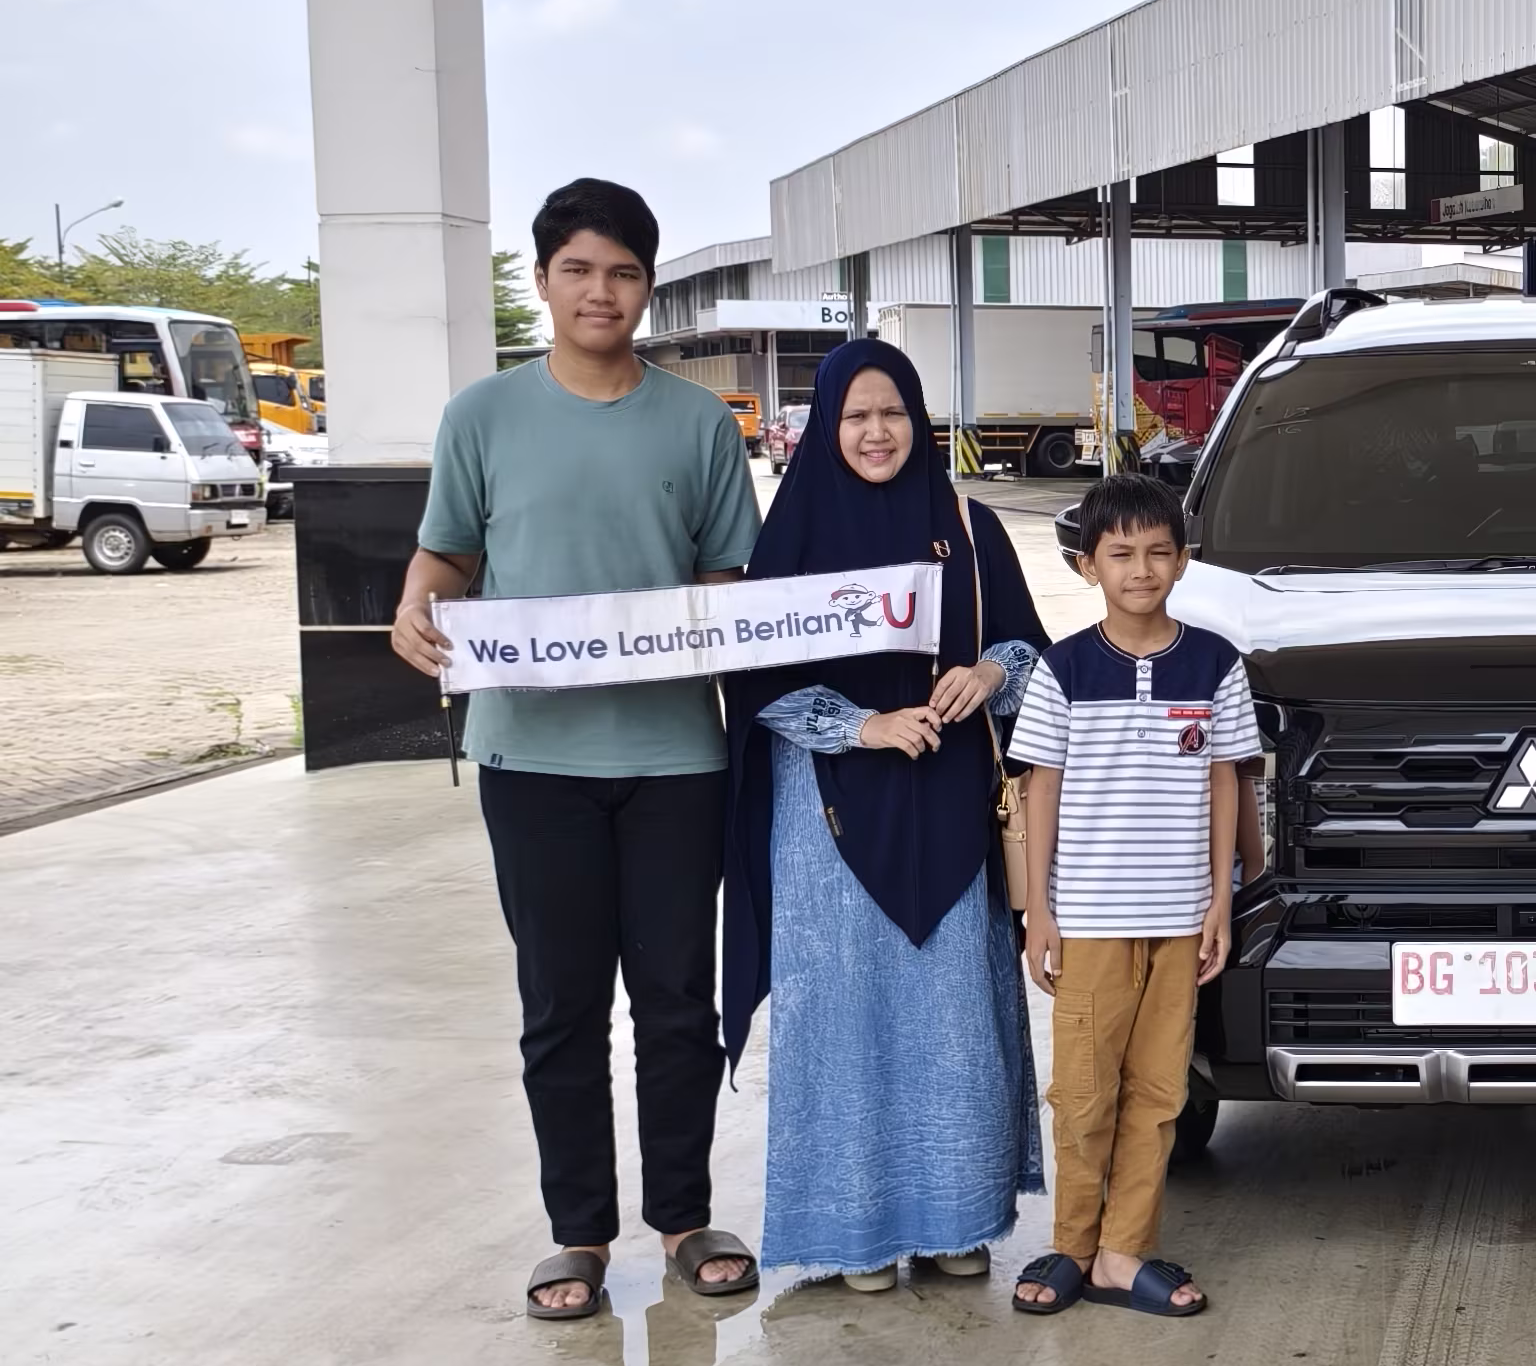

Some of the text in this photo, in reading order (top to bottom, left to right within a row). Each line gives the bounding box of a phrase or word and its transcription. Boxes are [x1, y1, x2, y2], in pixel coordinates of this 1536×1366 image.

[468, 639, 520, 664] We
[531, 636, 608, 663] Love
[618, 623, 726, 657] Lautan
[735, 609, 843, 644] Berlian
[1401, 950, 1454, 996] BG
